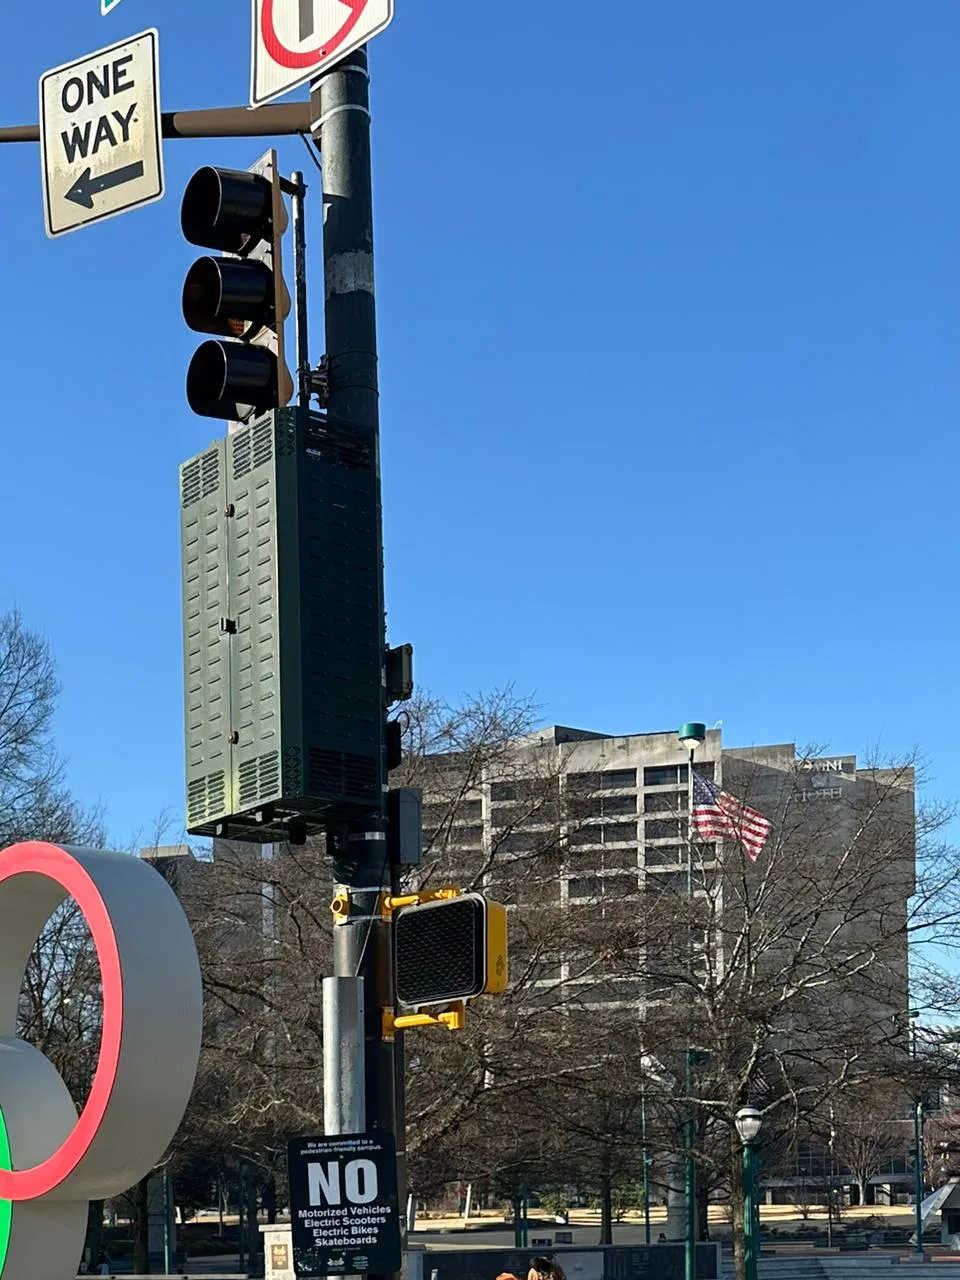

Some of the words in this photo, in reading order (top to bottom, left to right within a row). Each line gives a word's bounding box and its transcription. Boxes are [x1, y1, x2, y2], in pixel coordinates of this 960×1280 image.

[61, 54, 135, 113] ONE
[61, 102, 138, 164] WAY
[307, 1158, 378, 1206] NO
[298, 1207, 348, 1218] Motorized
[349, 1205, 392, 1215] Vehicles
[304, 1217, 340, 1228] Electric
[342, 1215, 387, 1225] Scooters
[313, 1227, 349, 1237] Electric
[351, 1226, 379, 1235] Bikes
[314, 1235, 378, 1247] Skateboards
